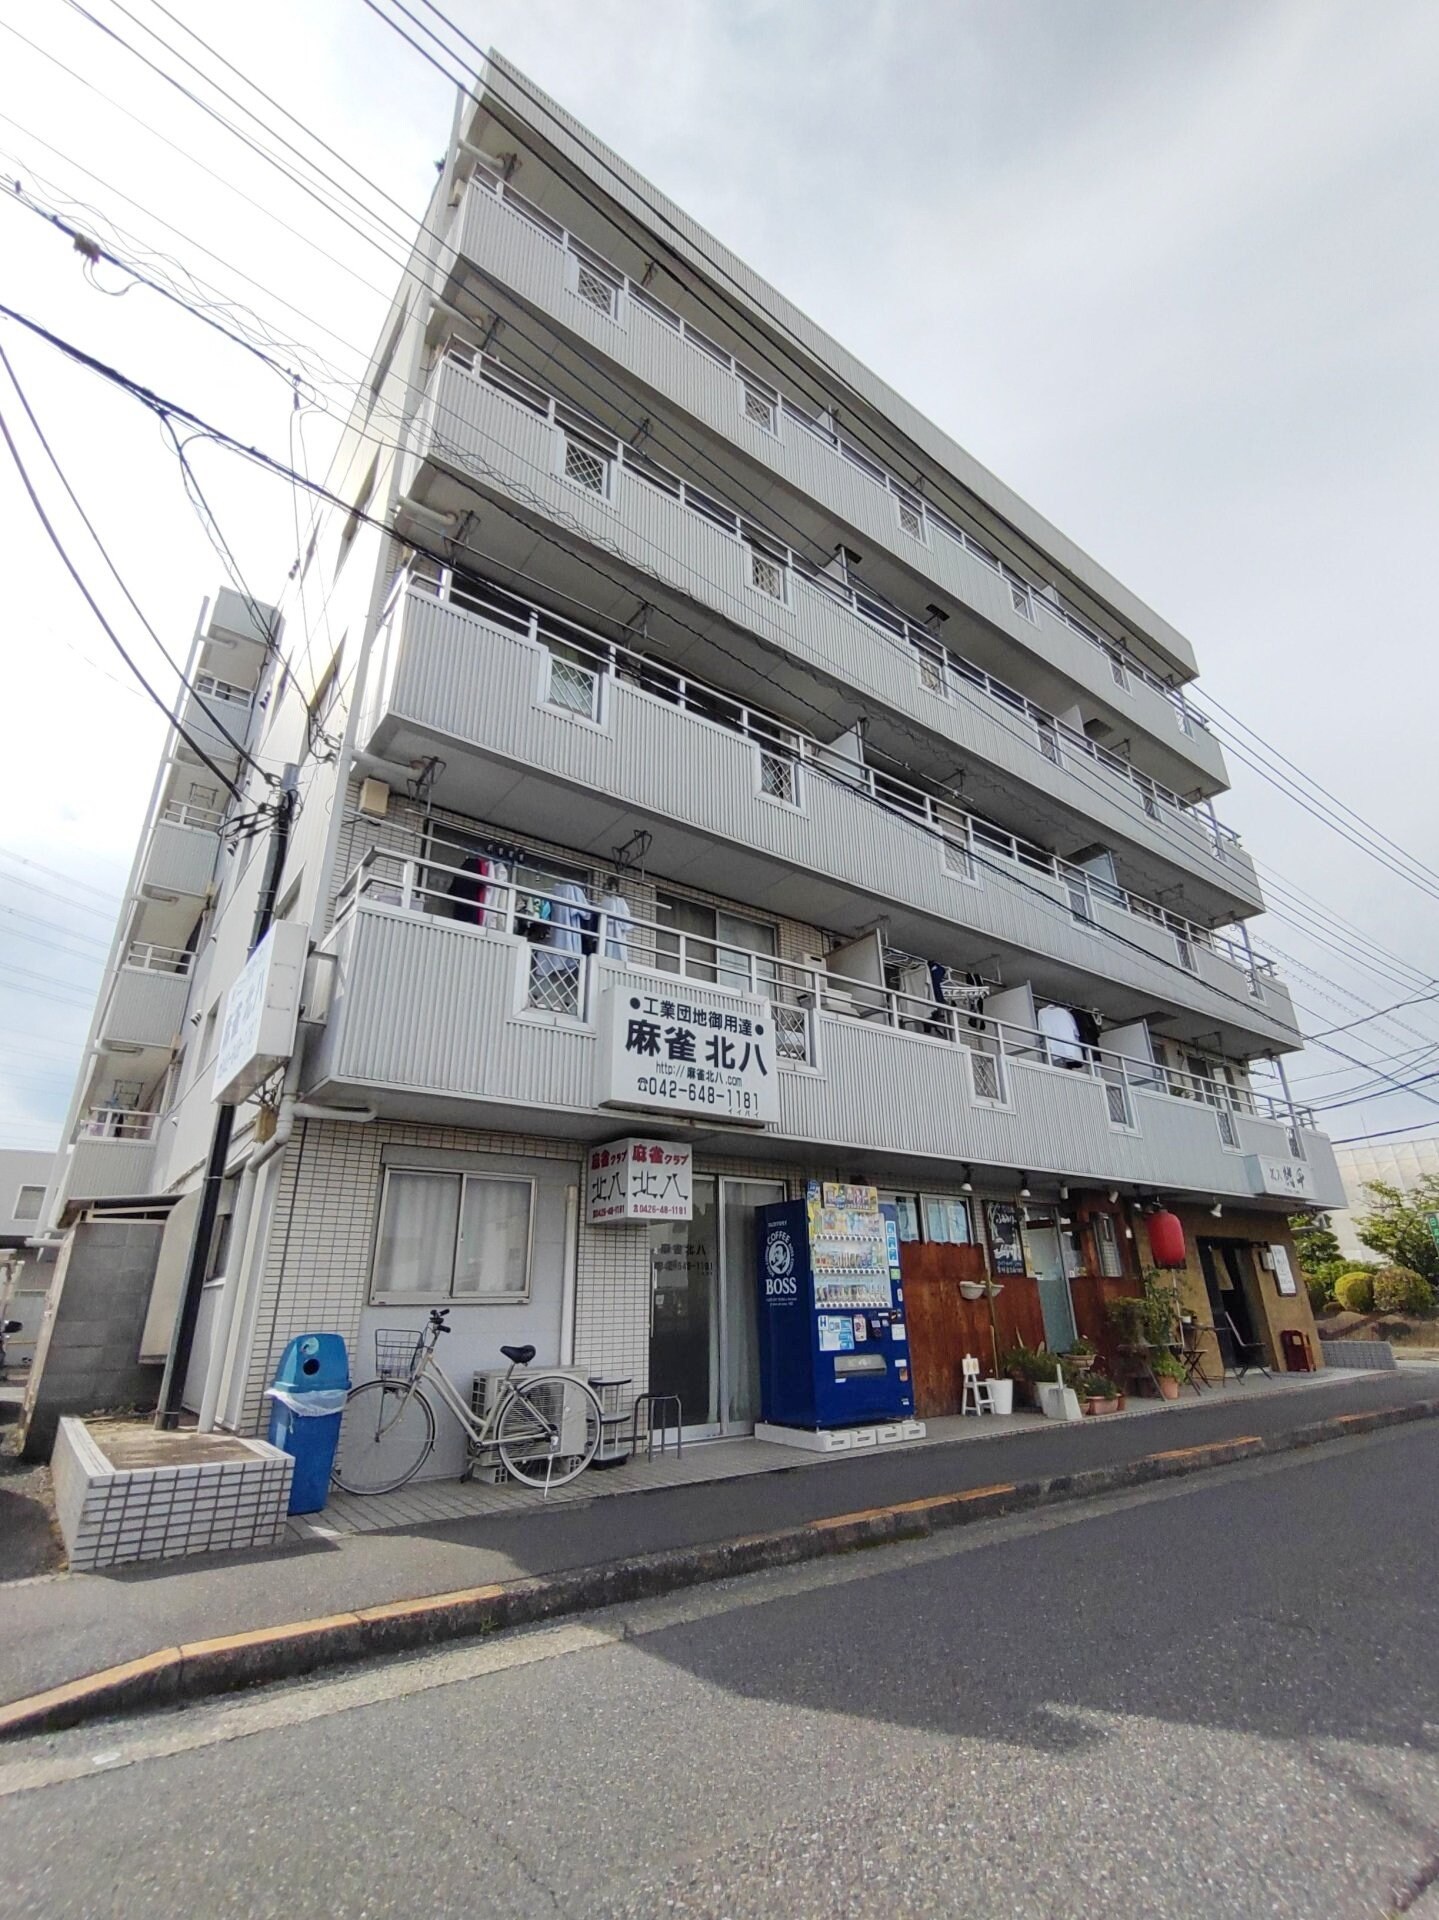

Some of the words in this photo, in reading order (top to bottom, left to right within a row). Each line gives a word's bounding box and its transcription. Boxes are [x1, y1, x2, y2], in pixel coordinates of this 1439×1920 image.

[643, 996, 753, 1037] 工業団地御用達
[625, 1019, 697, 1063] 麻雀
[705, 1034, 768, 1076] 北八
[632, 1144, 689, 1165] 麻雀クラブ
[592, 1171, 626, 1203] 北八
[632, 1170, 688, 1200] 北八
[767, 1230, 790, 1245] COFFEE
[766, 1277, 797, 1295] BOSS
